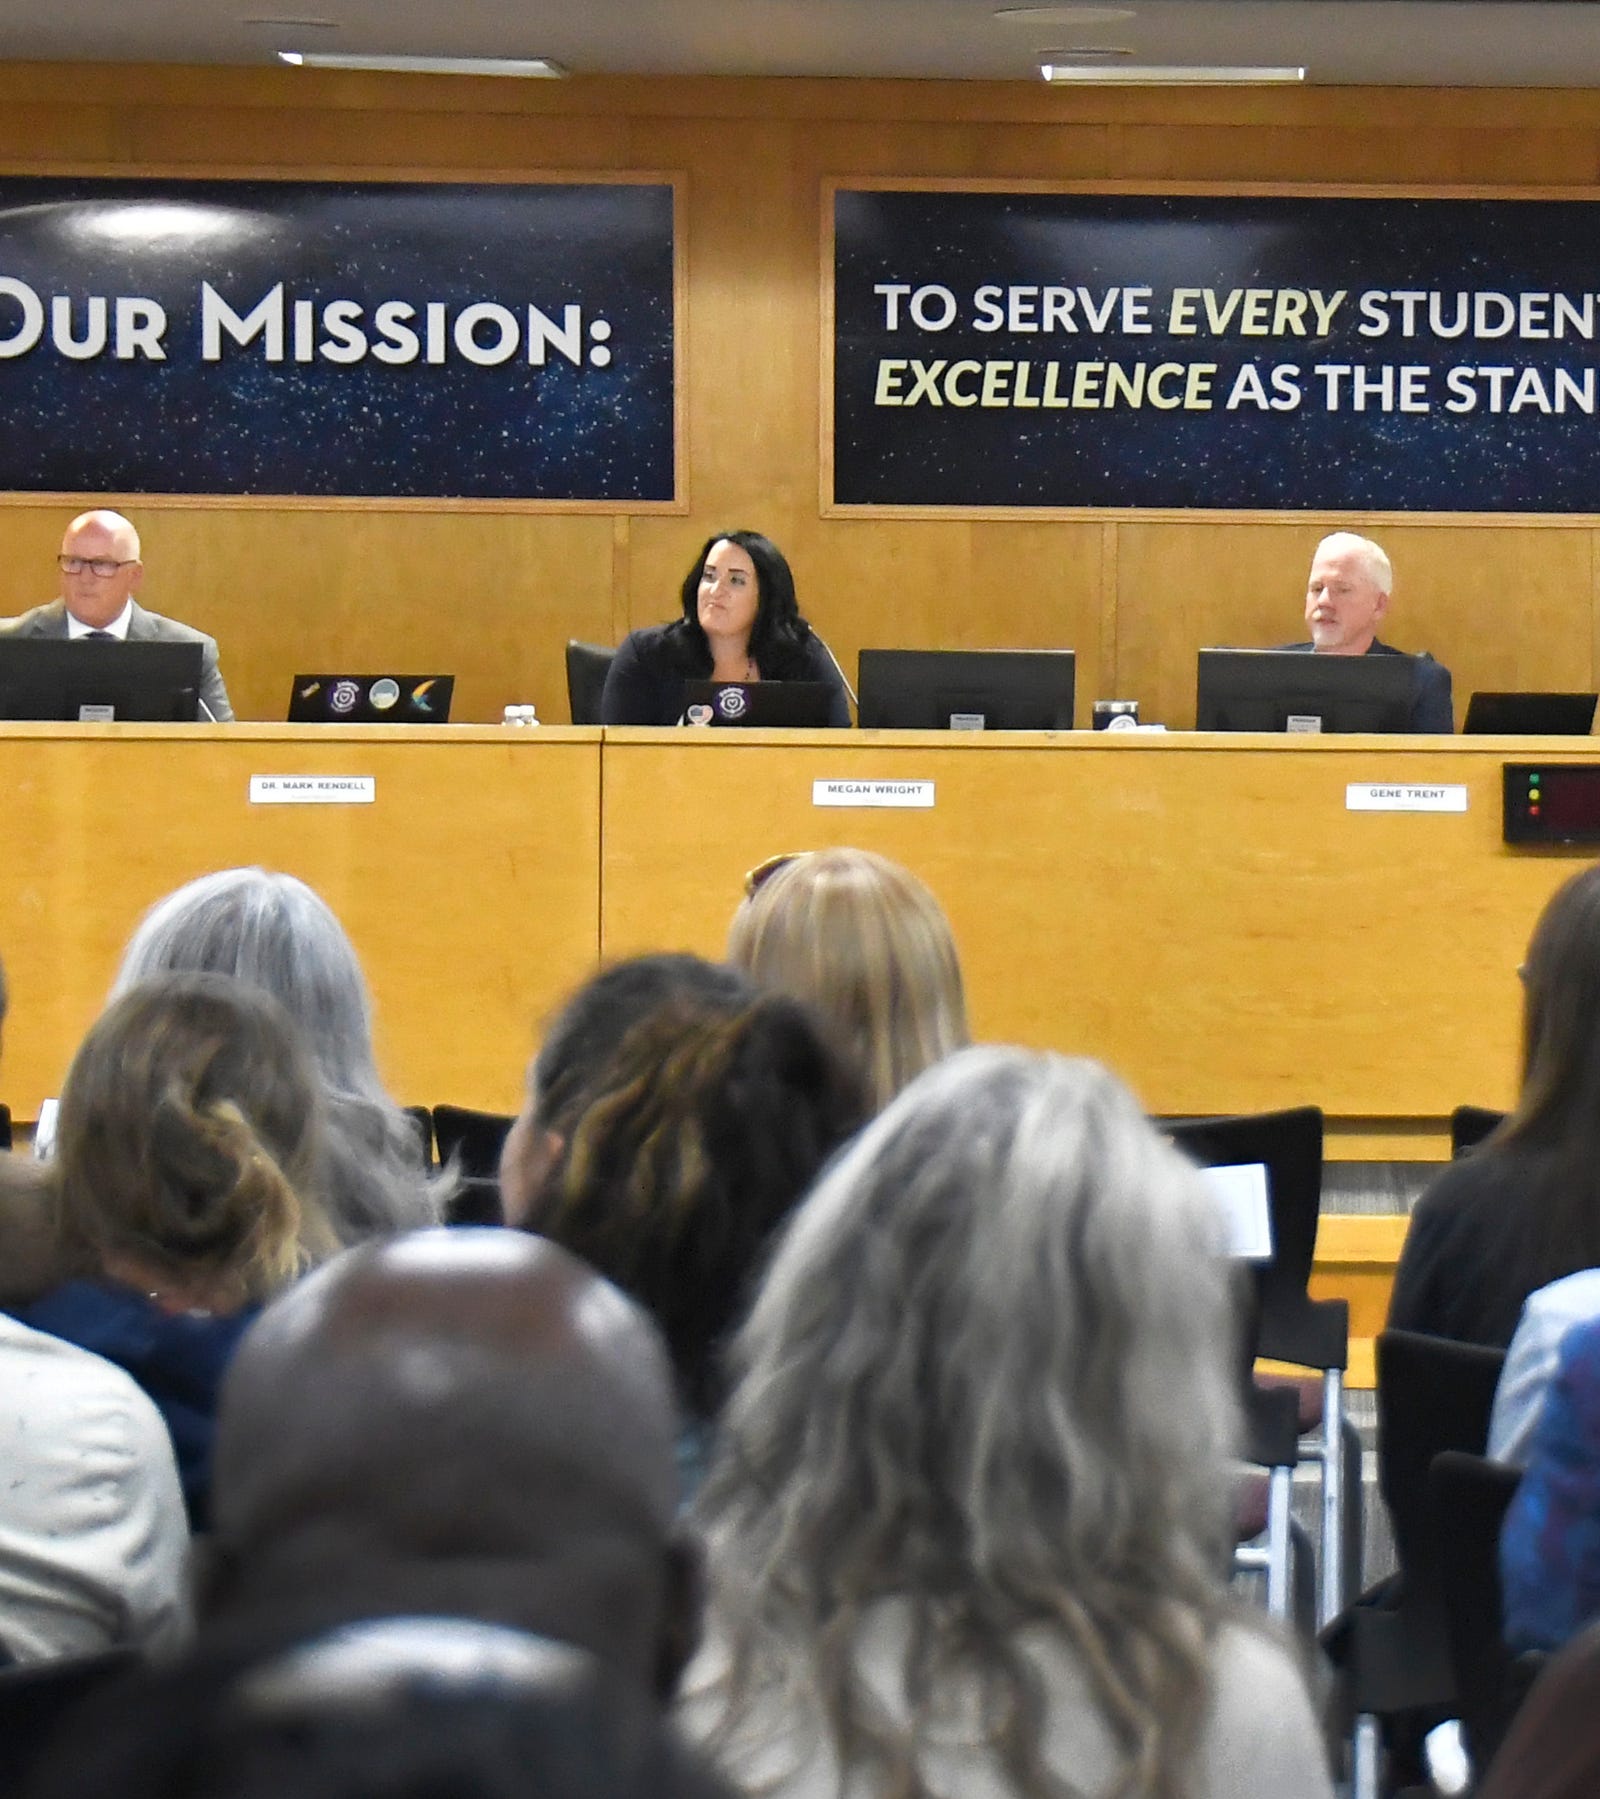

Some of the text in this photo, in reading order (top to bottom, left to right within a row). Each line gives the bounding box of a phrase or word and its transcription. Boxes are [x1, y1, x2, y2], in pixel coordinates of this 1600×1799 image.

[201, 280, 612, 367] MISSION:
[873, 283, 958, 332] TO
[972, 284, 1153, 334] SERVE
[1168, 287, 1349, 336] EVERY
[873, 358, 1219, 410] EXCELLENCE
[1225, 364, 1302, 411] AS
[1314, 364, 1431, 413] THE
[283, 781, 313, 790] MARK
[318, 781, 366, 790] RENDELL
[827, 785, 923, 794] MEGAN WRIGHT
[1370, 788, 1446, 798] GENE TRENT
